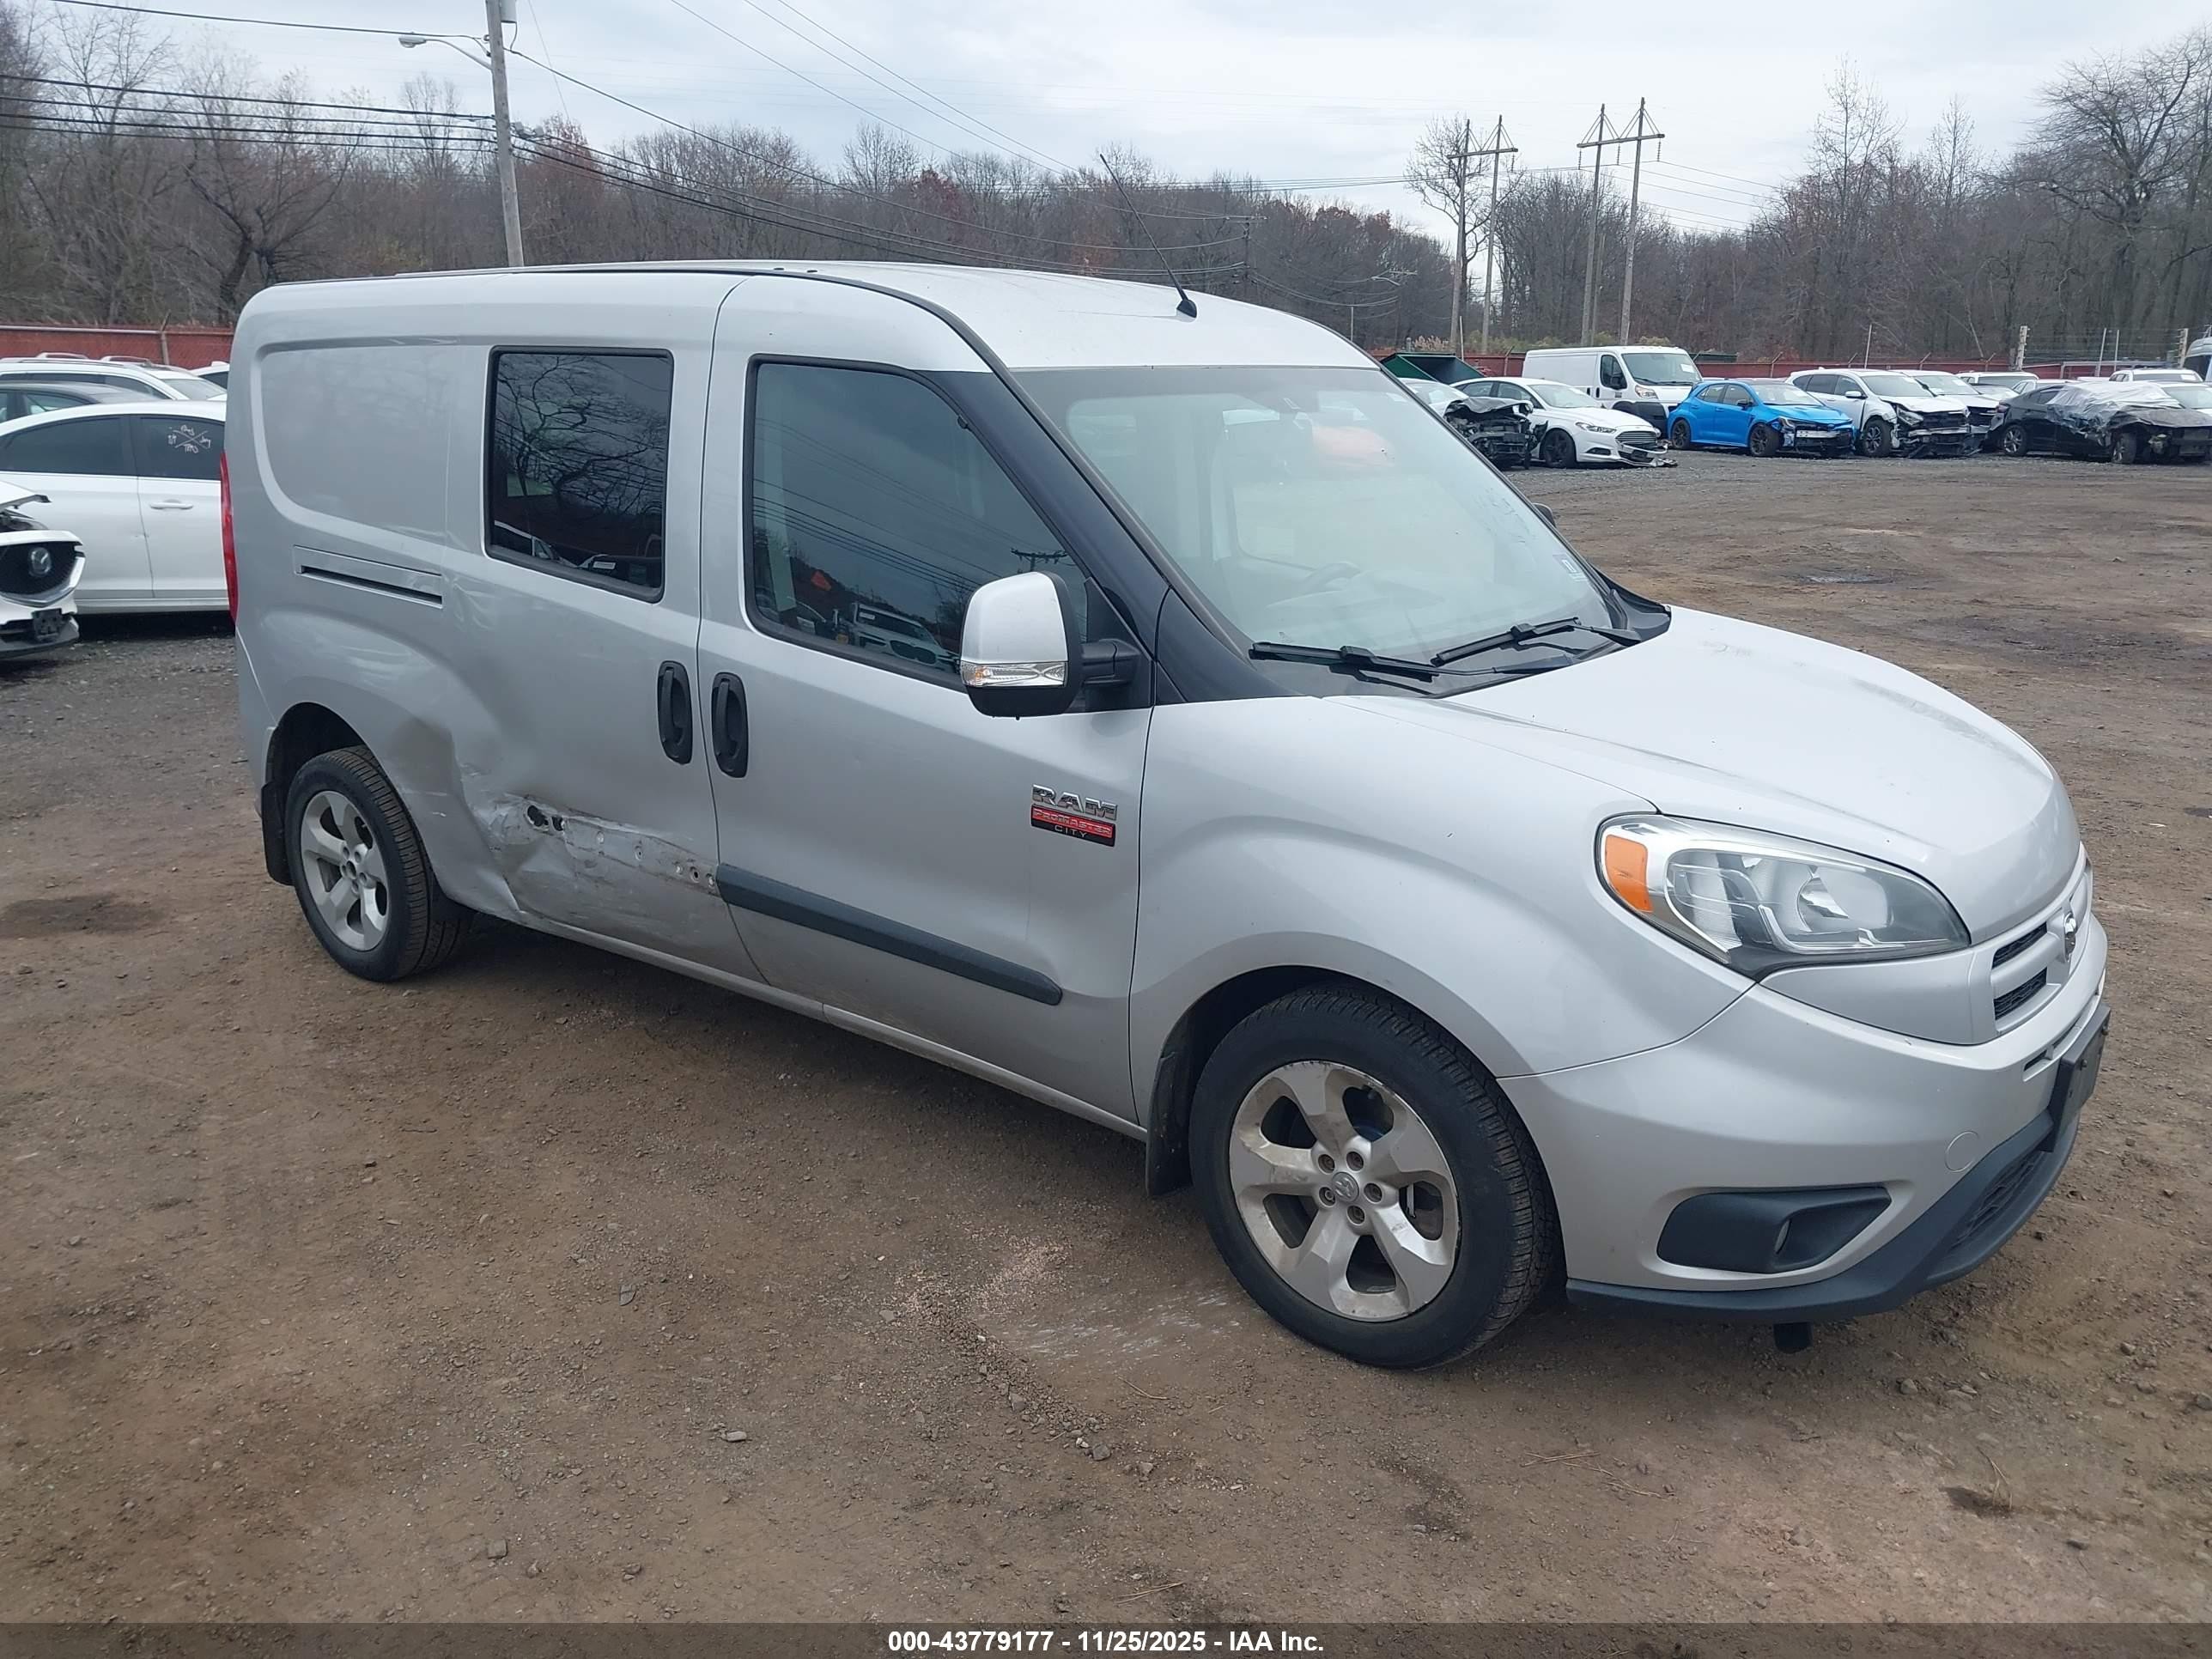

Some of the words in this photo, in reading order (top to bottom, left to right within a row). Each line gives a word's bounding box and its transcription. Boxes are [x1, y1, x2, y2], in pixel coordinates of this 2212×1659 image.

[1032, 783, 1118, 821] RAM
[1032, 808, 1114, 839] PROMASTER
[1054, 825, 1088, 838] CITY
